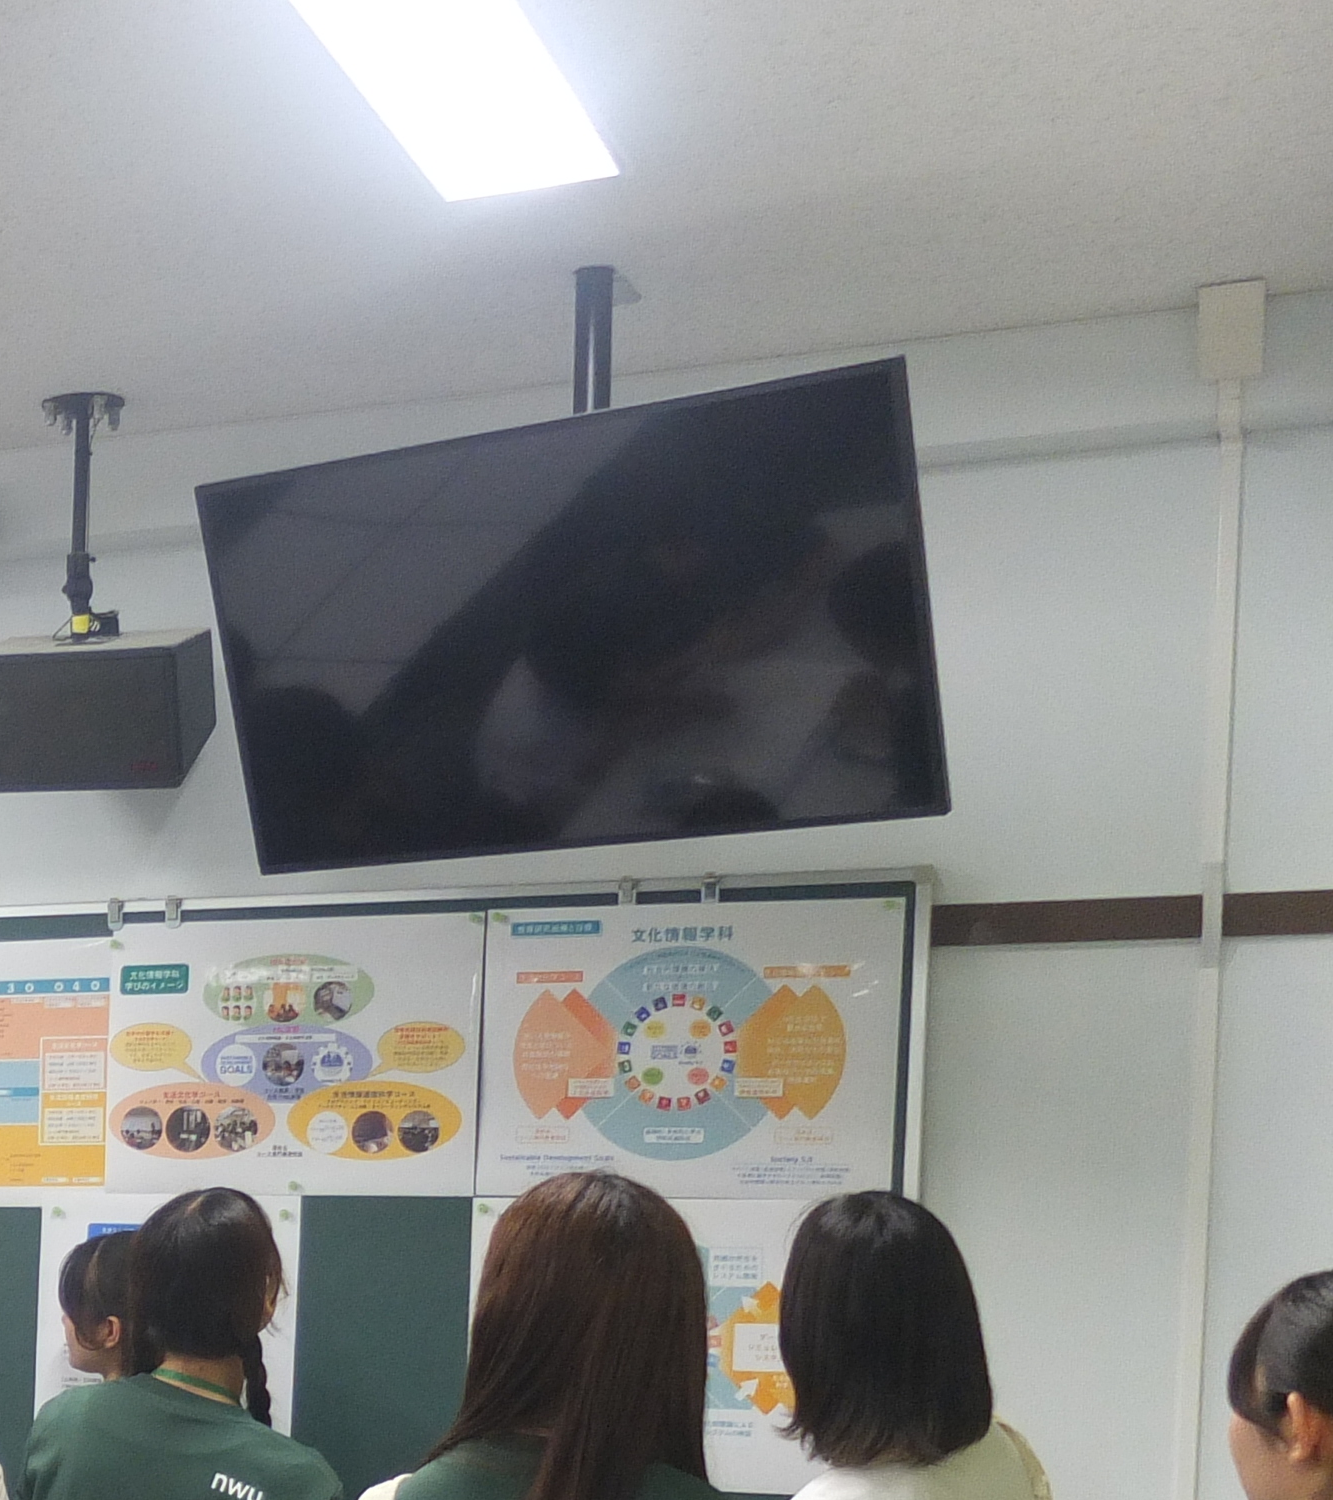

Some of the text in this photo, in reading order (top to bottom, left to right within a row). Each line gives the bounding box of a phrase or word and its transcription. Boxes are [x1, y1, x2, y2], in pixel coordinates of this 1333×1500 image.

[631, 925, 733, 943] 文化情報学科
